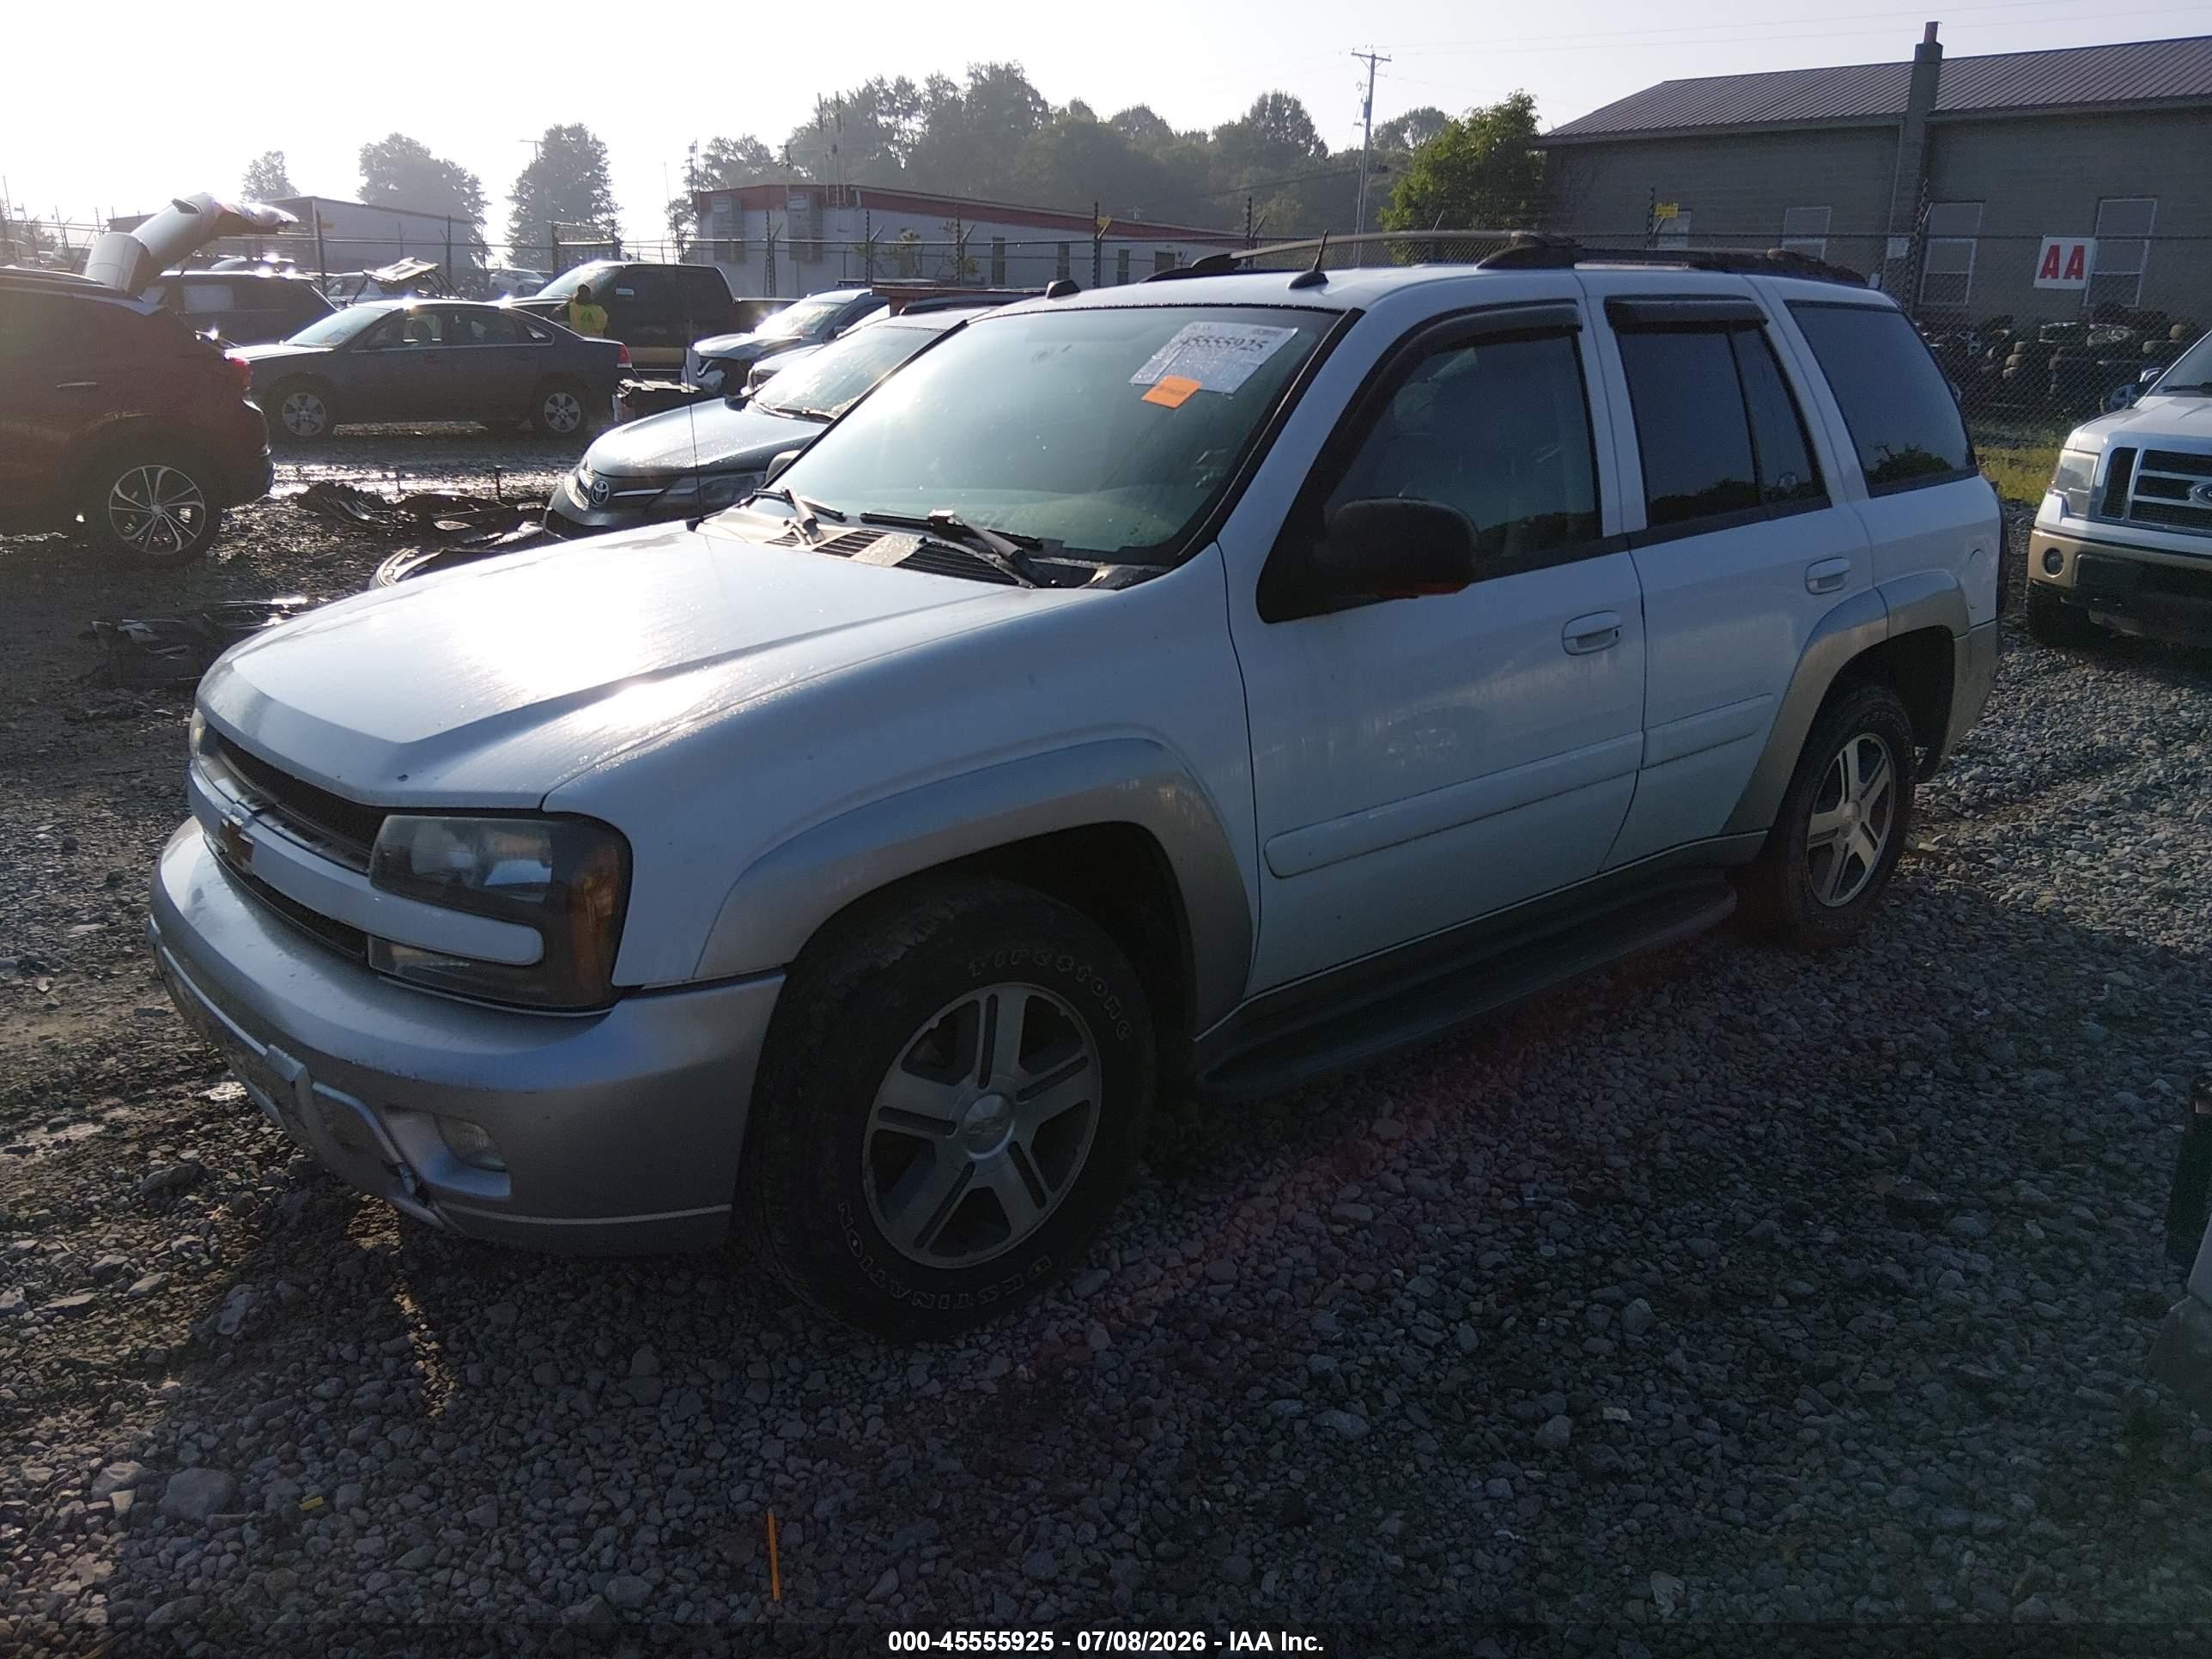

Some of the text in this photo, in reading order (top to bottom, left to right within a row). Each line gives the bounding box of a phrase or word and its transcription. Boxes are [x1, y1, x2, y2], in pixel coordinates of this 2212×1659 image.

[2039, 245, 2085, 280] AA
[968, 945, 1133, 1042] Firestone
[837, 1200, 1053, 1310] DESTINATION
